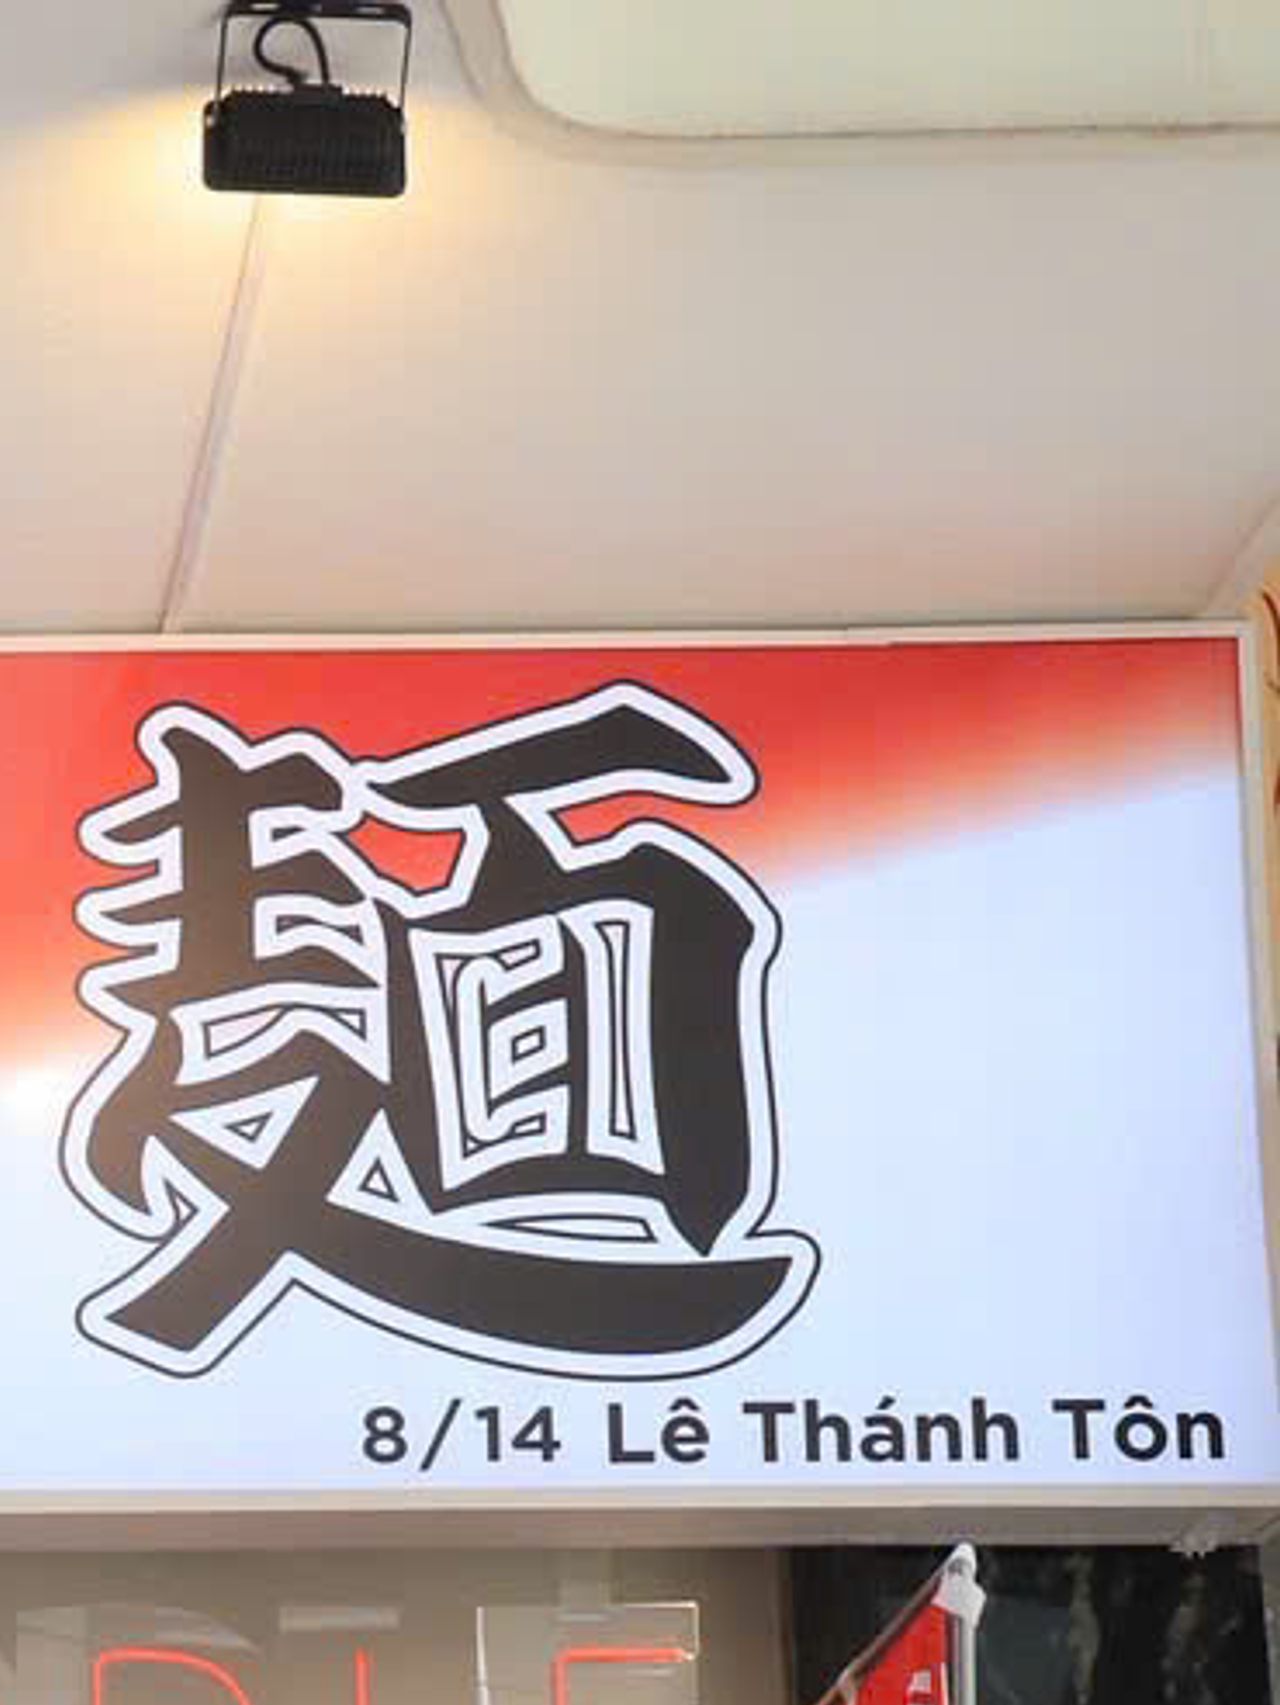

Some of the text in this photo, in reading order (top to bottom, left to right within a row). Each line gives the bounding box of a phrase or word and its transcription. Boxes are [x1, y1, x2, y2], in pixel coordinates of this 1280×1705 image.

[362, 1394, 1225, 1470] 8/14 Lê Thánh Tôn
